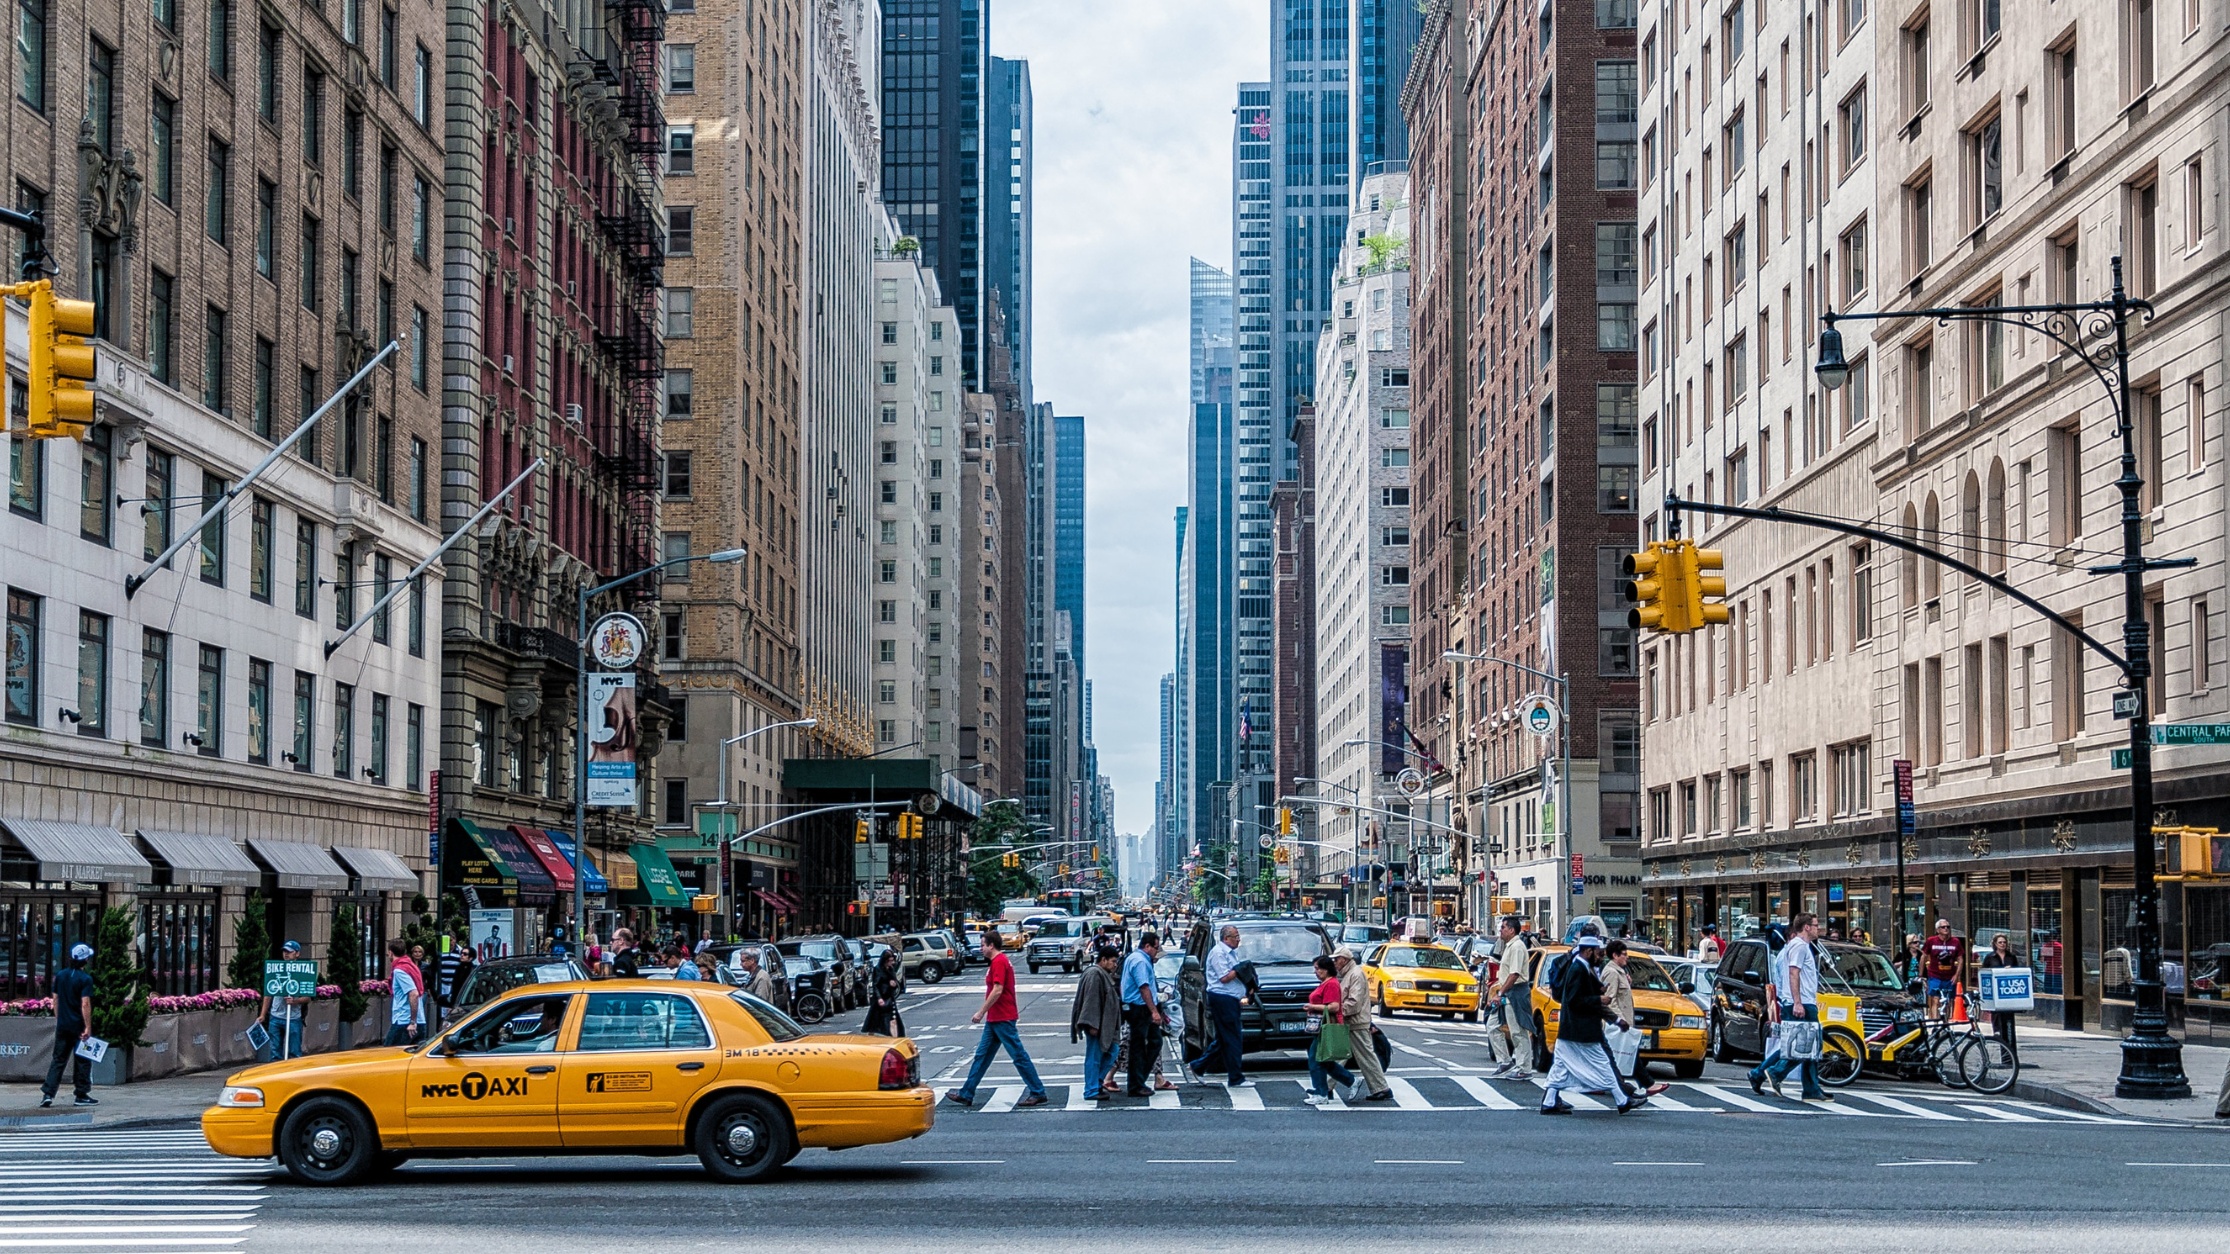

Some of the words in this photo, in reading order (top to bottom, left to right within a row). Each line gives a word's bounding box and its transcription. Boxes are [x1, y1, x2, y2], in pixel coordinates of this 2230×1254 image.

[602, 658, 633, 667] BARBADOS
[601, 677, 623, 686] NYC
[2116, 700, 2126, 711] ONE
[2167, 726, 2211, 737] CENTRAL
[61, 864, 74, 879] BLT
[75, 865, 104, 880] MARKET
[675, 870, 696, 878] PARK
[266, 962, 284, 974] BIKE
[286, 962, 315, 975] RENTAL
[2007, 979, 2025, 987] USA
[1999, 986, 2027, 995] TODAY
[421, 1084, 459, 1098] NYC
[461, 1074, 528, 1098] TAXI
